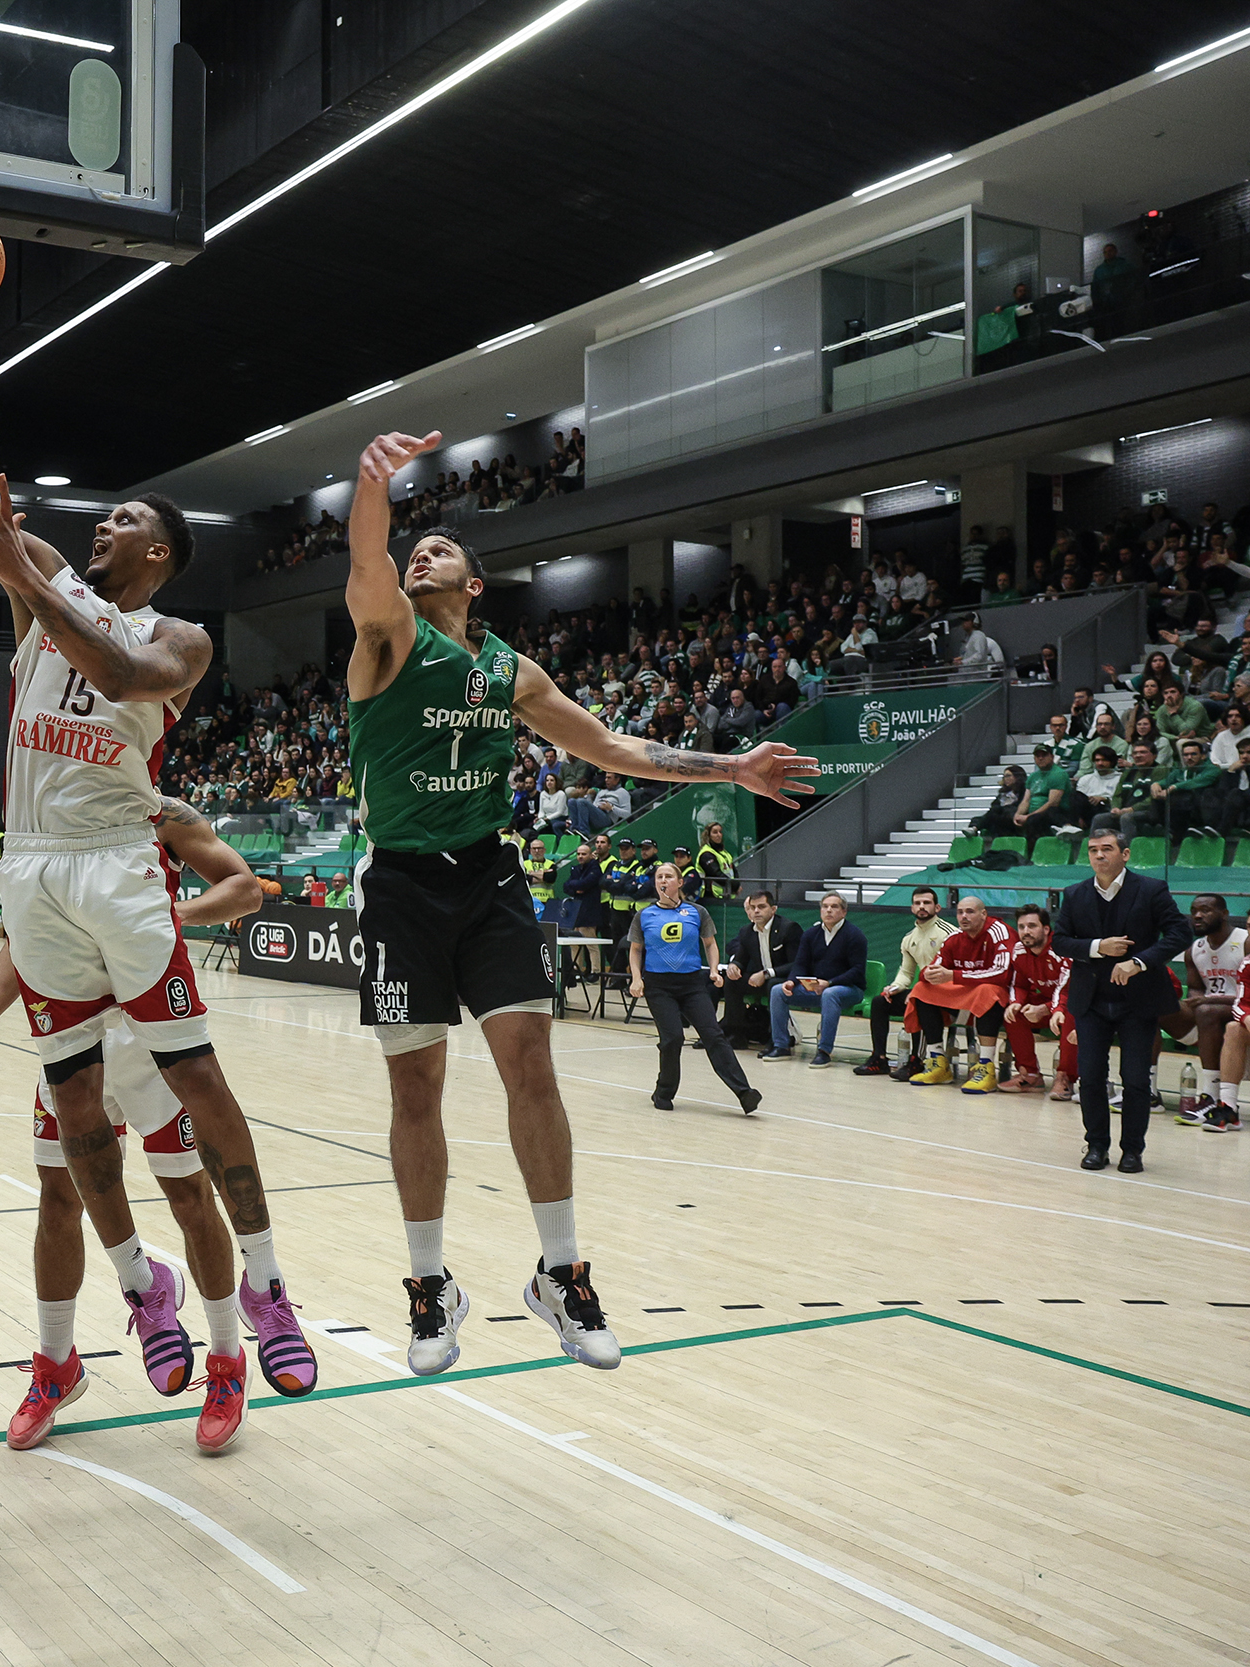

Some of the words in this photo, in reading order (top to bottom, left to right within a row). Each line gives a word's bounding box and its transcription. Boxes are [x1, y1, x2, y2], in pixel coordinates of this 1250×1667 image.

[59, 667, 95, 717] 15
[863, 701, 885, 711] SCP
[422, 707, 510, 729] SPORTING
[892, 705, 956, 725] PAVILHÃO
[36, 711, 113, 739] conservas
[16, 719, 127, 766] RAMIREZ
[891, 728, 915, 742] João
[450, 729, 464, 770] 1
[821, 763, 834, 774] DE
[269, 928, 285, 943] LIGA
[666, 925, 678, 936] G
[269, 944, 287, 955] Betclic
[308, 921, 344, 964] DÁ
[376, 941, 385, 981] 1
[371, 981, 408, 995] TRAN
[1209, 978, 1225, 993] 32
[374, 995, 408, 1010] QUILI
[377, 1009, 409, 1023] DADE
